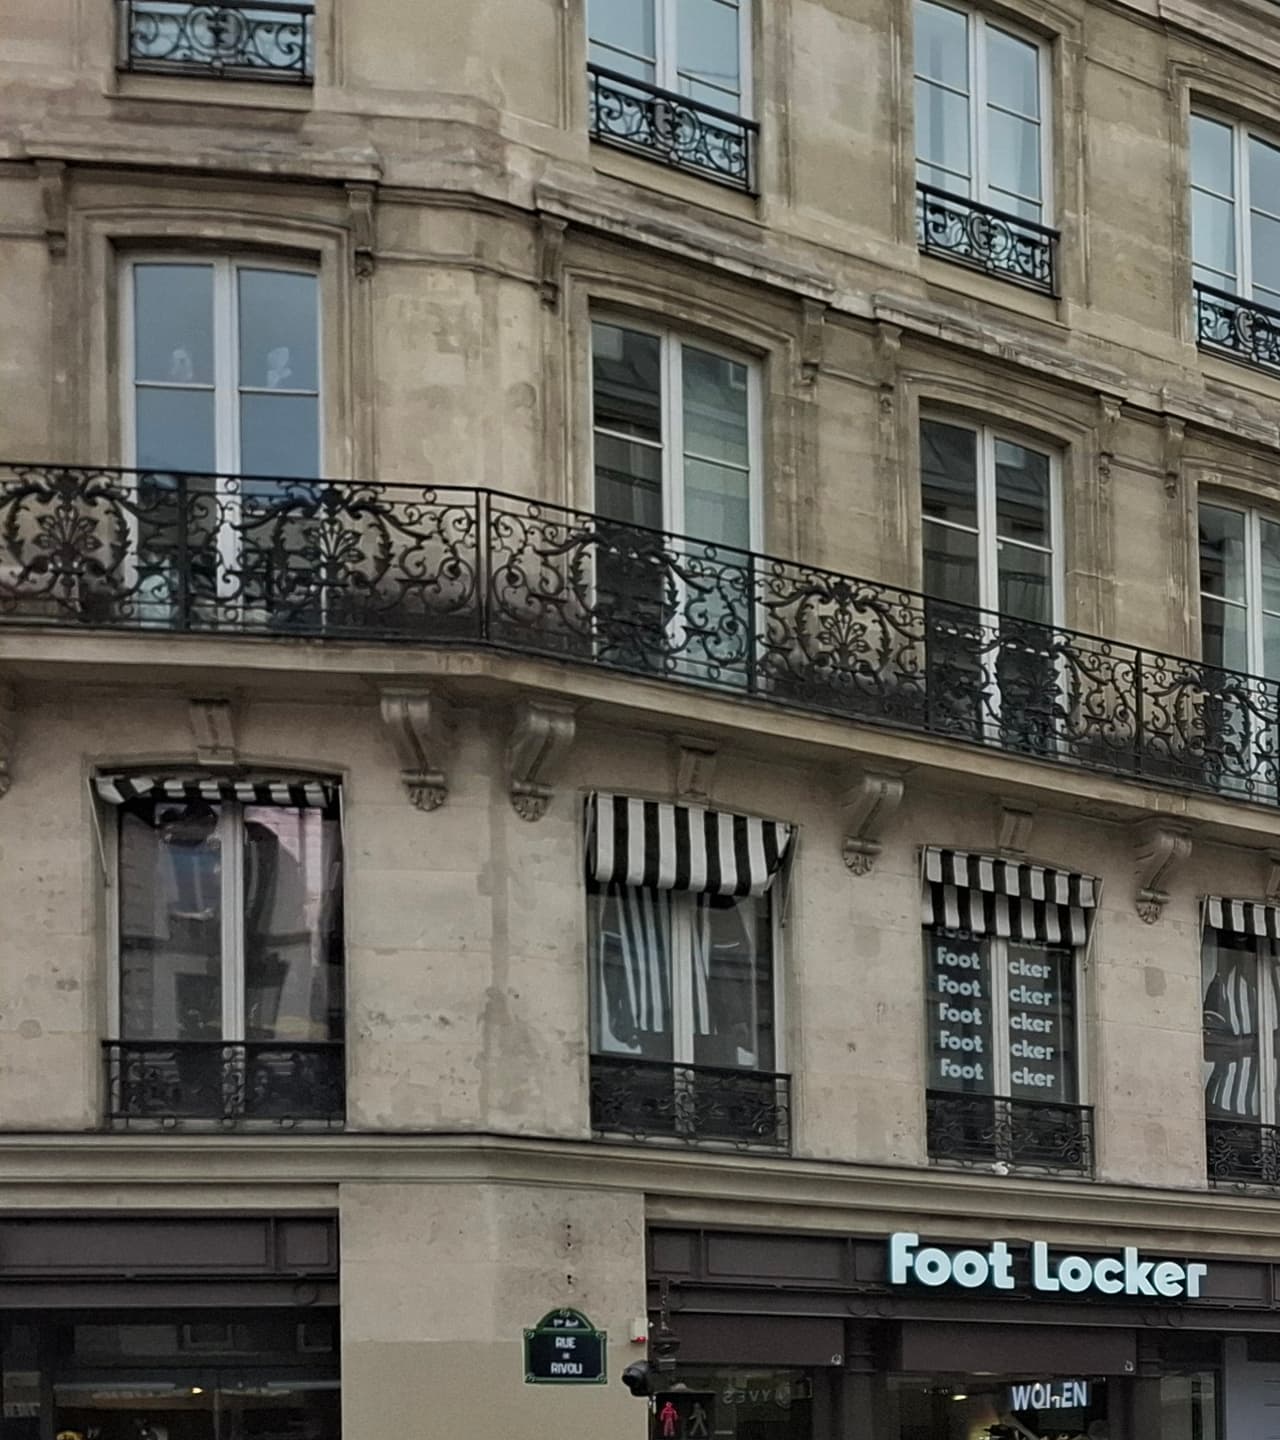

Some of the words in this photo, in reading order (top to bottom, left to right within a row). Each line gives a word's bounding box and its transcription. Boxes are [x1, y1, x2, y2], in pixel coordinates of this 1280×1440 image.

[937, 946, 981, 970] Foot
[938, 974, 982, 998] Foot
[939, 1003, 982, 1026] Foot
[940, 1030, 983, 1053] Foot
[940, 1058, 984, 1081] Foot
[890, 1232, 1015, 1289] Foot
[1034, 1240, 1207, 1297] Locker
[555, 1336, 576, 1349] RUE
[551, 1362, 582, 1374] RIVOLI
